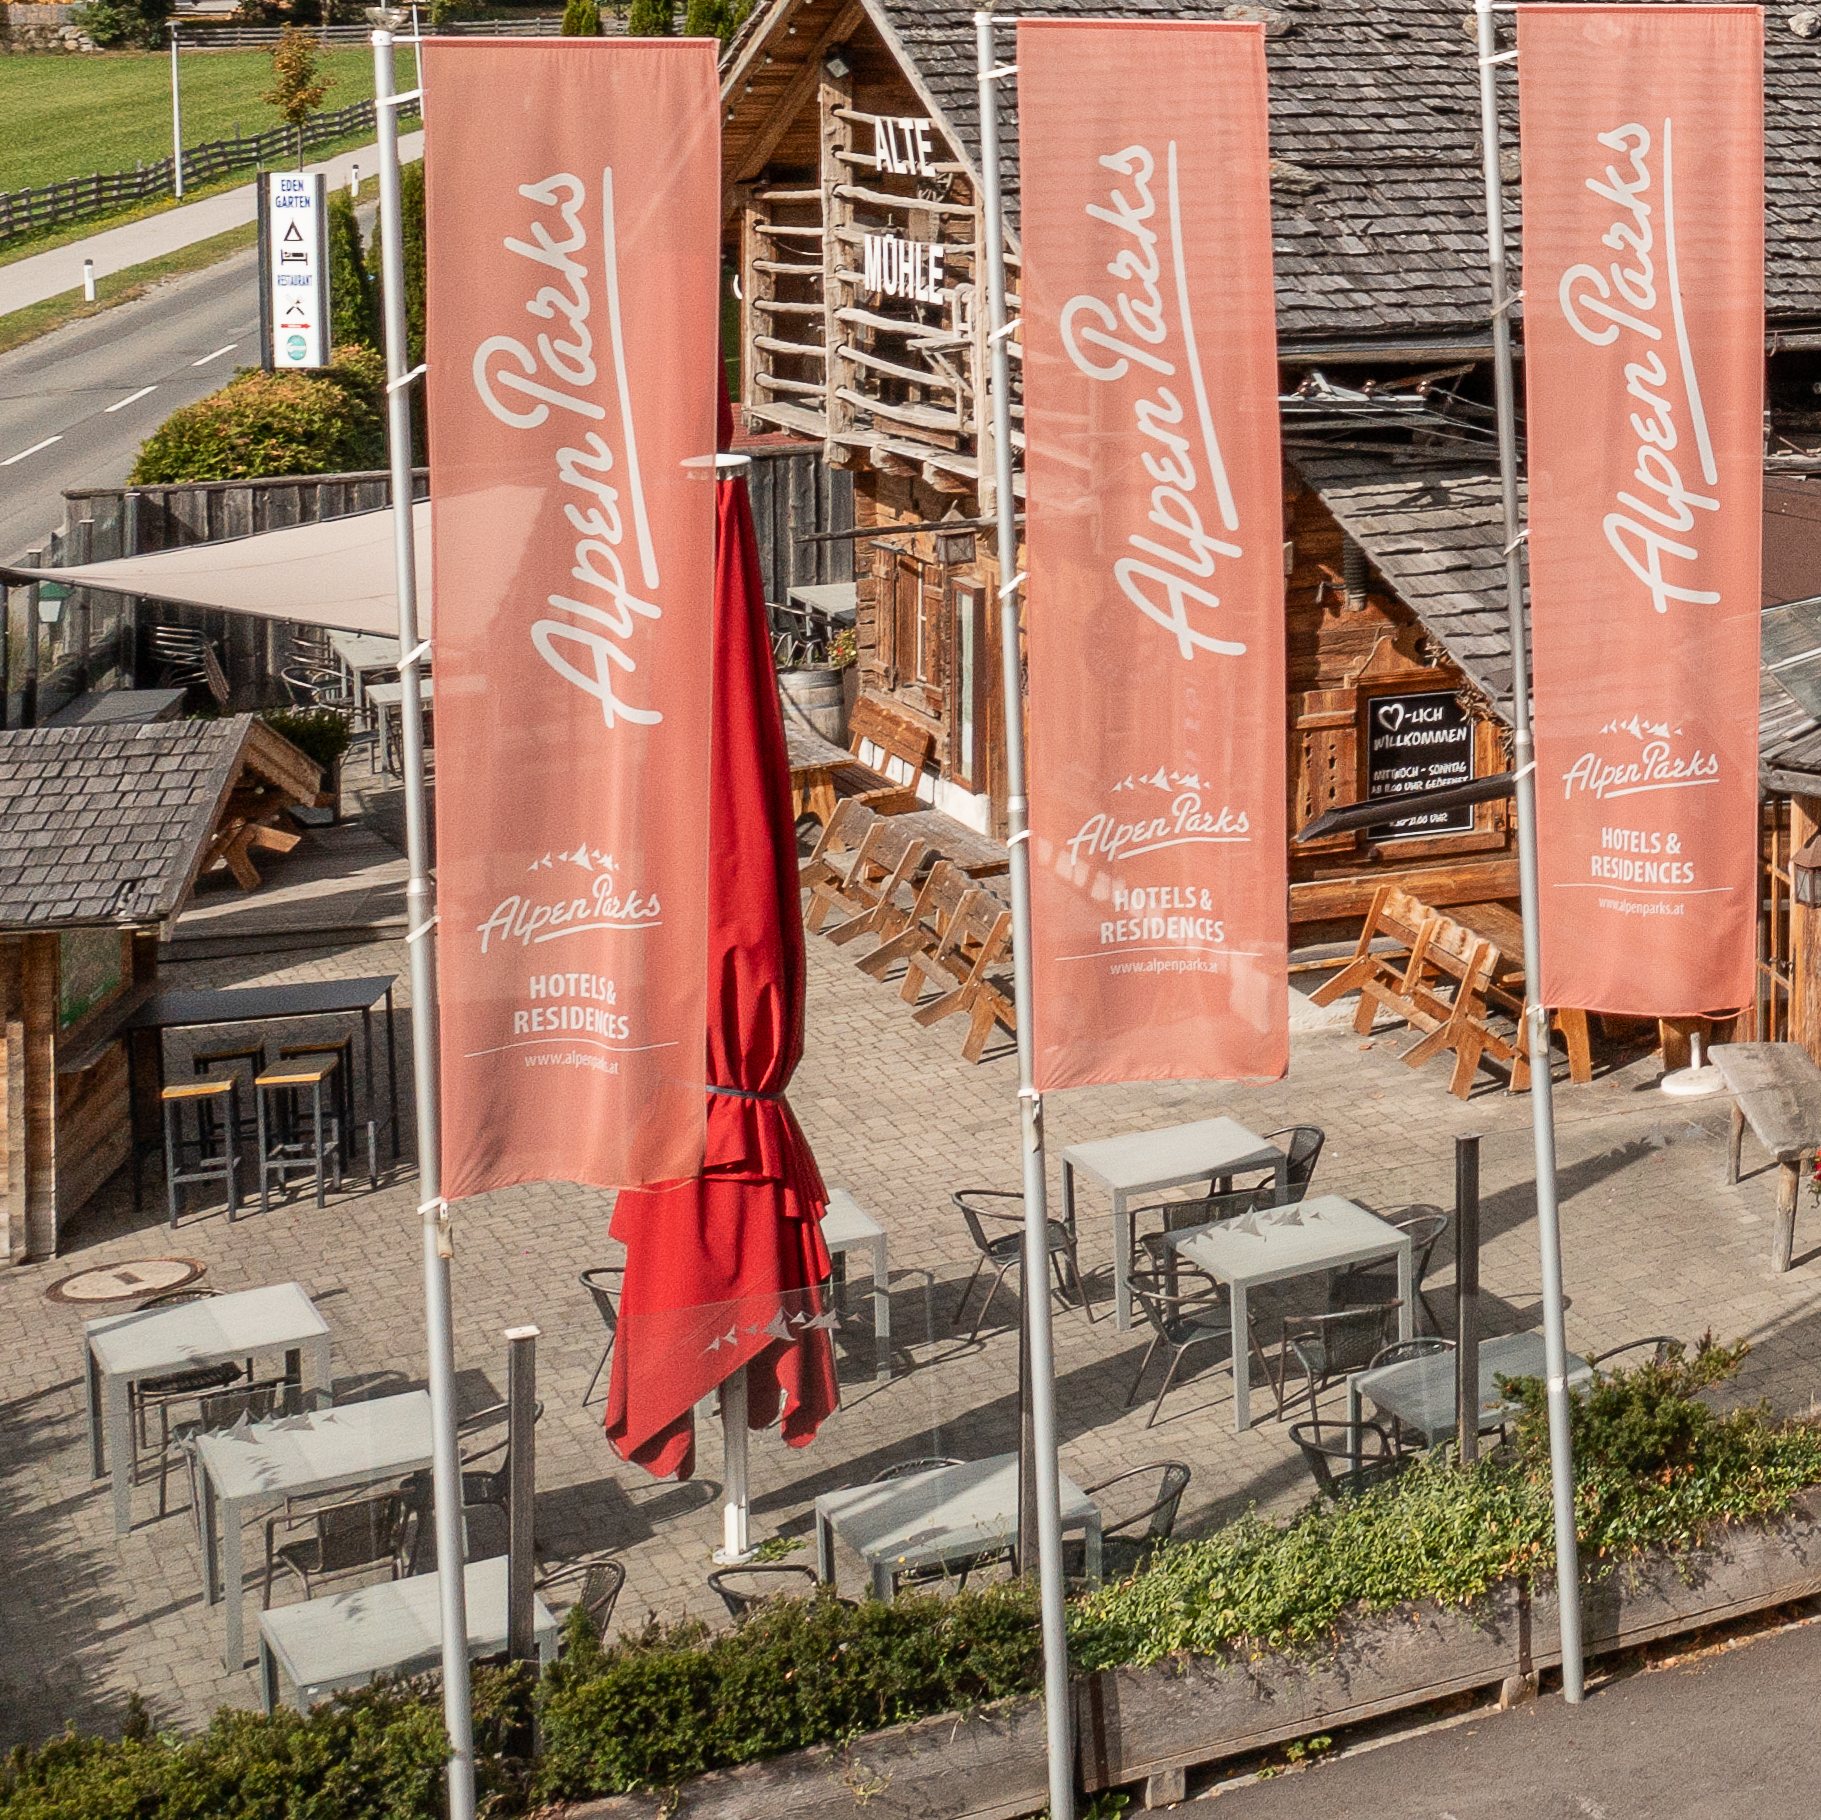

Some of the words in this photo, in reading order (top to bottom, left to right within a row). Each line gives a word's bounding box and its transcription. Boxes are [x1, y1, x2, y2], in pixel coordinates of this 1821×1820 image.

[875, 116, 935, 177] ALTE
[281, 179, 304, 192] EDEN
[276, 196, 311, 208] GARTEN
[864, 234, 944, 305] MÜHLE
[1373, 727, 1467, 751] WILLKOMMEN
[1374, 766, 1419, 780] MITTWOCH
[1429, 762, 1467, 776] SONNTAG
[1404, 780, 1424, 791] UHR
[1601, 827, 1661, 854] HOTELS
[1666, 833, 1681, 854] &
[1591, 855, 1694, 884] RESIDENCES
[1113, 886, 1197, 912] HOTELS
[1200, 888, 1212, 911] &
[1598, 897, 1685, 917] www.alpenparks.at
[1100, 916, 1225, 944] RESIDENCES
[1110, 957, 1218, 974] www.alpenparks.at
[529, 973, 605, 1001] HOTELS
[606, 980, 617, 1005] &
[514, 1006, 630, 1040] RESIDENCES
